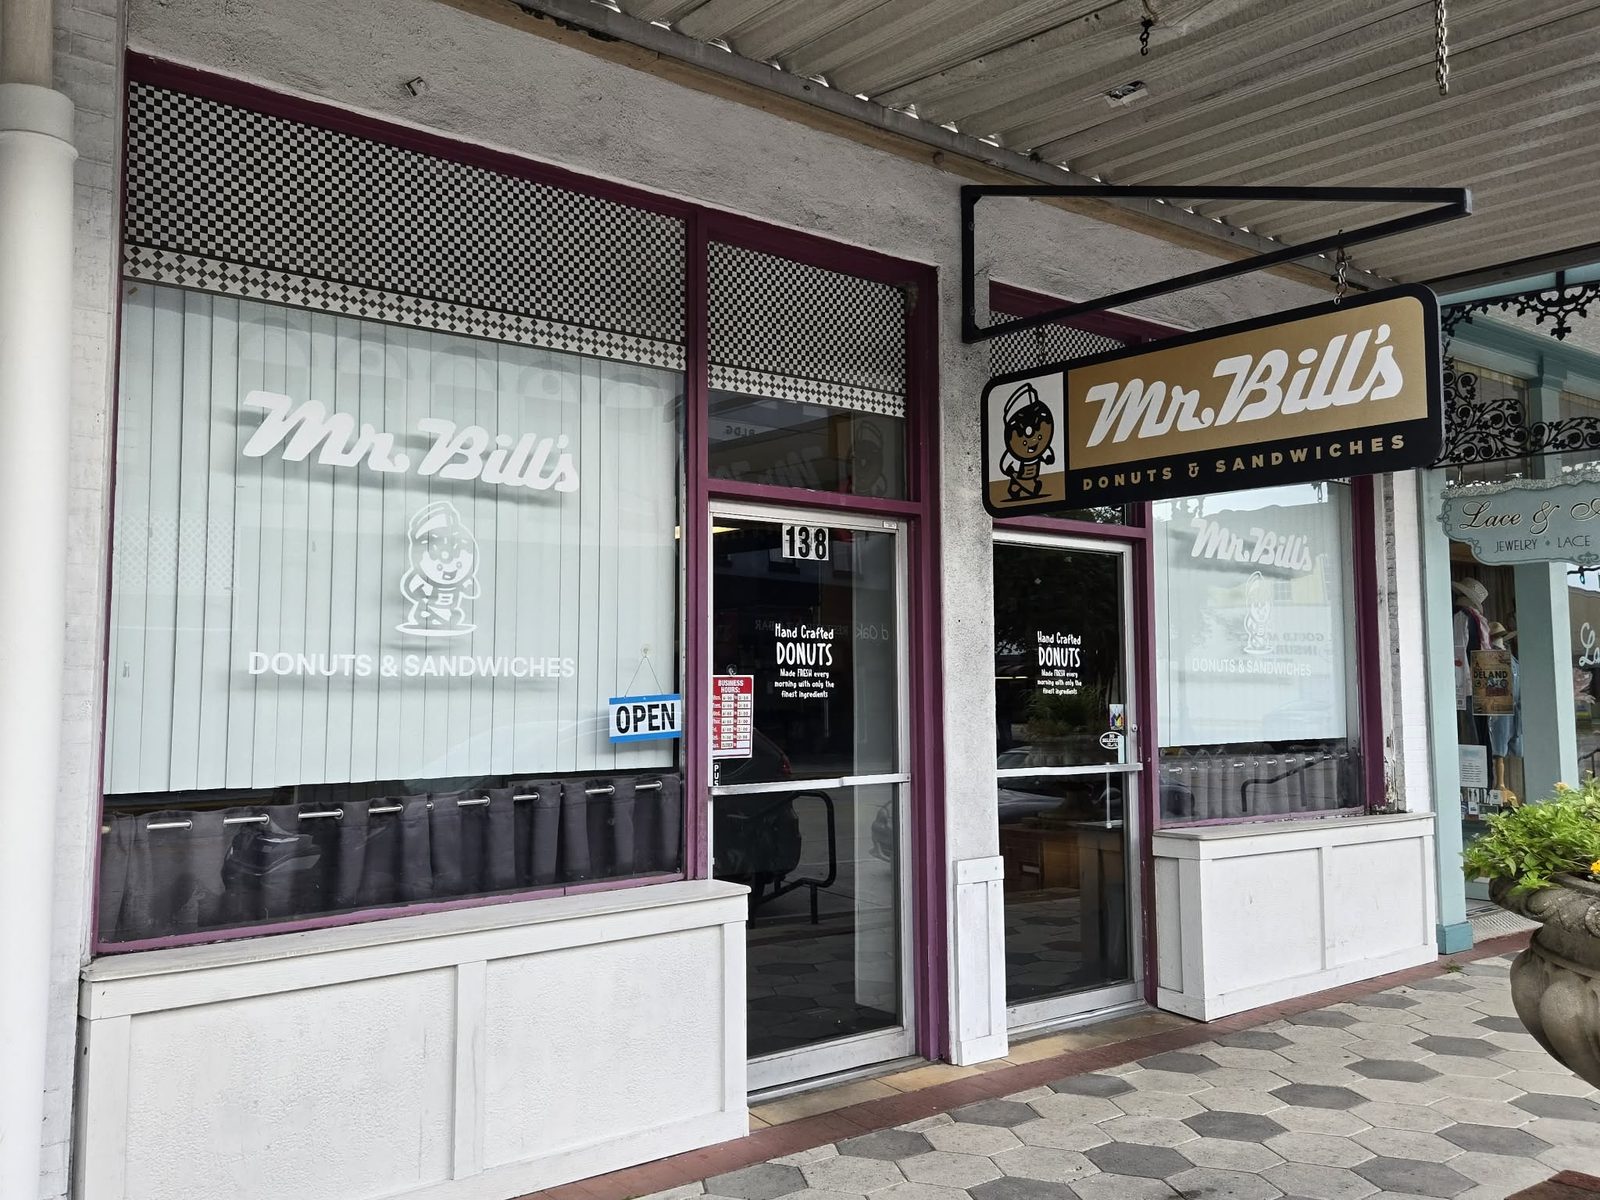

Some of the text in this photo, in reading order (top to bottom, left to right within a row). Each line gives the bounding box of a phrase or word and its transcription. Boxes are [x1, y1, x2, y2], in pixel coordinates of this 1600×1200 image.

[1085, 323, 1404, 448] Mr. Bill's
[243, 390, 580, 493] Mr. Bill's
[1082, 434, 1406, 491] DONUTS & SANDWICHES
[1460, 500, 1521, 530] Lace
[1530, 501, 1560, 535] &
[785, 526, 827, 560] 138
[1191, 518, 1313, 571] Mr. Bill's
[1494, 535, 1591, 553] JEWELRY LACE
[775, 622, 798, 638] Hand
[801, 624, 834, 640] Crafted
[1037, 630, 1082, 645] Hand Crafted
[249, 651, 575, 678] DONUTS & SANDWICHES
[776, 641, 833, 666] DONUTS
[1038, 646, 1081, 668] DONUTS
[780, 668, 796, 677] Made
[813, 671, 830, 679] every
[1192, 657, 1236, 673] DONUTS
[1246, 659, 1312, 677] SANDWICHES
[1474, 670, 1508, 679] DELAND
[718, 679, 744, 687] BUSINESS
[798, 679, 811, 688] with
[811, 679, 824, 689] only
[825, 680, 835, 688] the
[615, 703, 676, 734] OPEN
